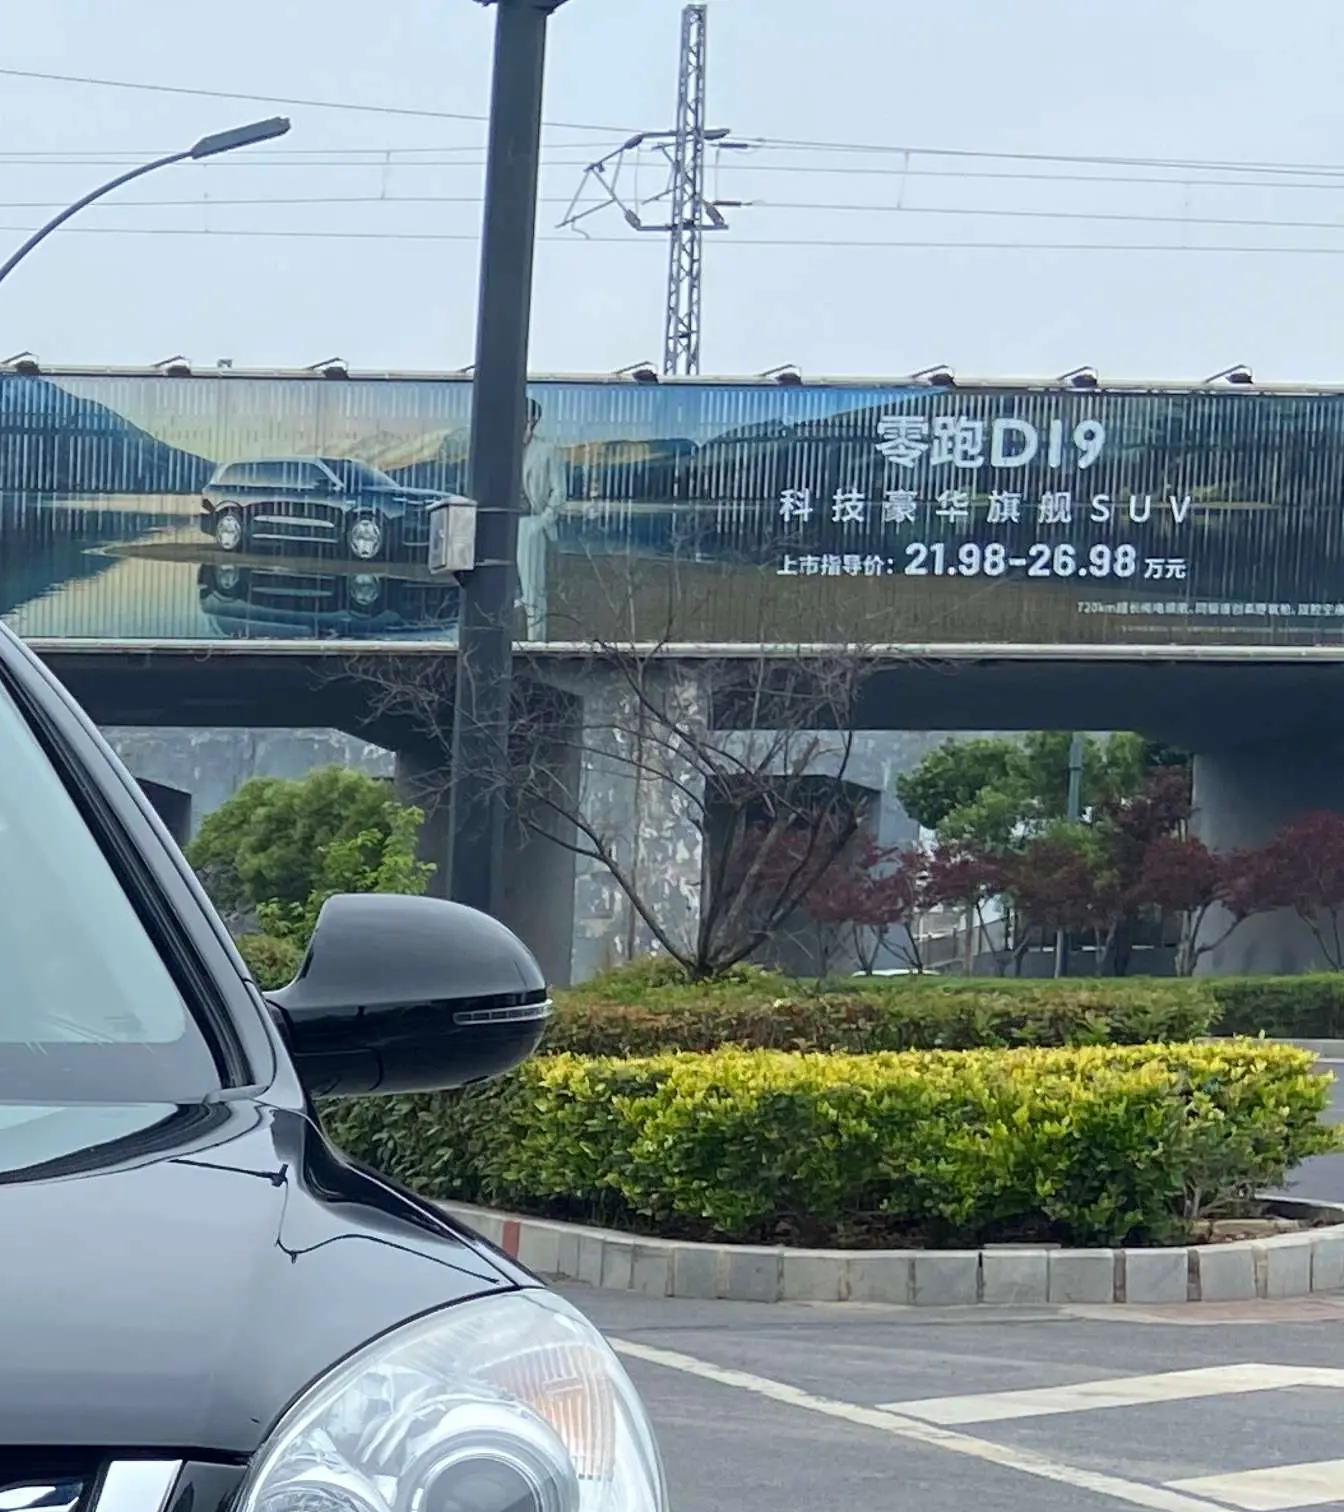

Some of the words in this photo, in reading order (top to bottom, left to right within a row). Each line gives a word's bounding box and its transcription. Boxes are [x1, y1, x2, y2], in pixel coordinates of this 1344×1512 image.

[875, 415, 1105, 470] 零跑D19
[904, 542, 1136, 577] 21.98-26.98
[1144, 558, 1187, 580] 万元
